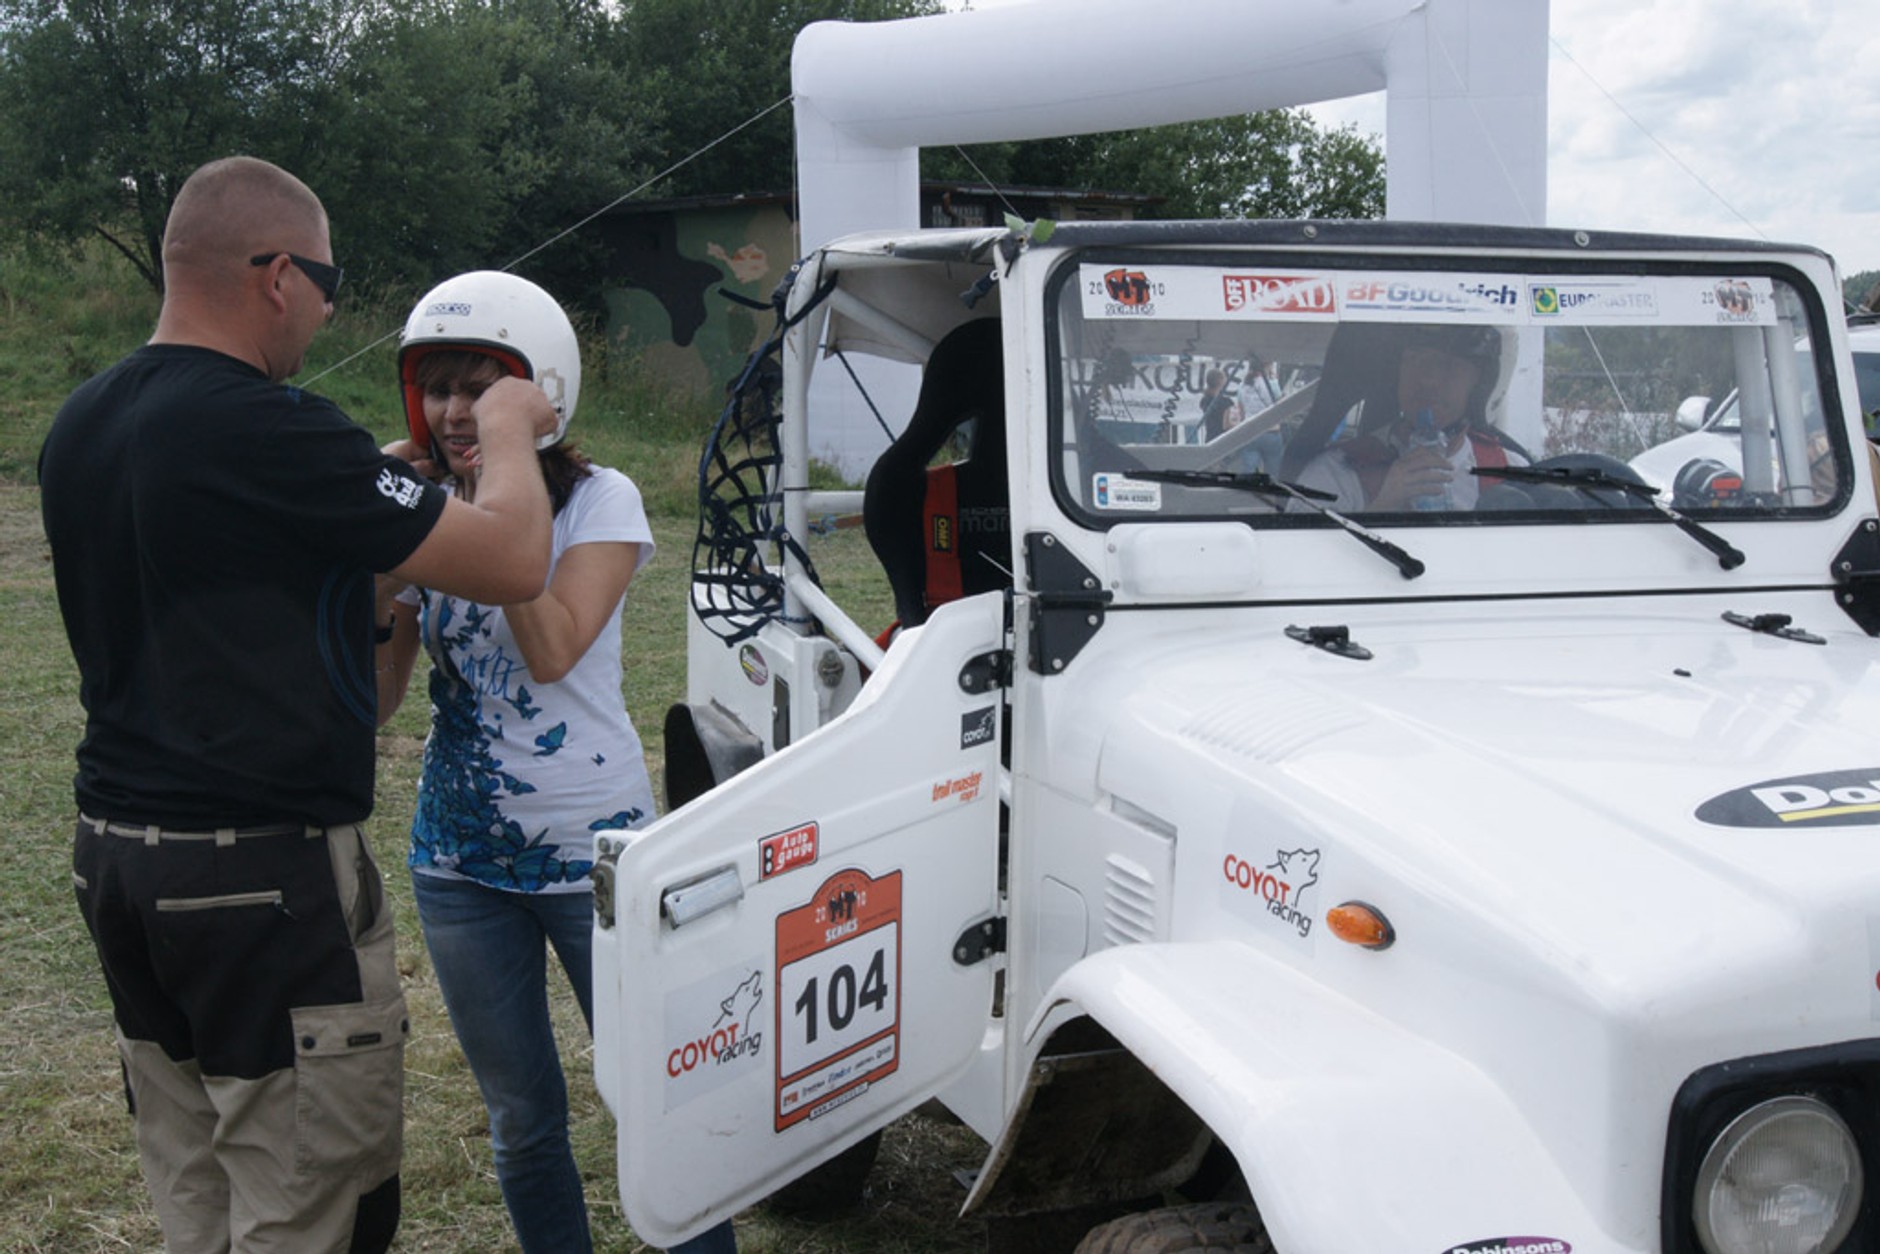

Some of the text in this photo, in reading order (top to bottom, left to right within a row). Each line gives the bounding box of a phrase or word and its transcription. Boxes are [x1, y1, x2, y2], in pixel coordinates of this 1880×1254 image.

[1089, 281, 1103, 296] 20
[1227, 279, 1243, 307] OFF
[1750, 780, 1880, 813] Do
[774, 842, 813, 872] gauge
[781, 832, 808, 850] Auto
[1223, 853, 1290, 904] COYOT
[1266, 898, 1312, 938] racing
[795, 948, 888, 1044] 104
[667, 1022, 739, 1078] COYOT
[716, 1032, 762, 1066] racing
